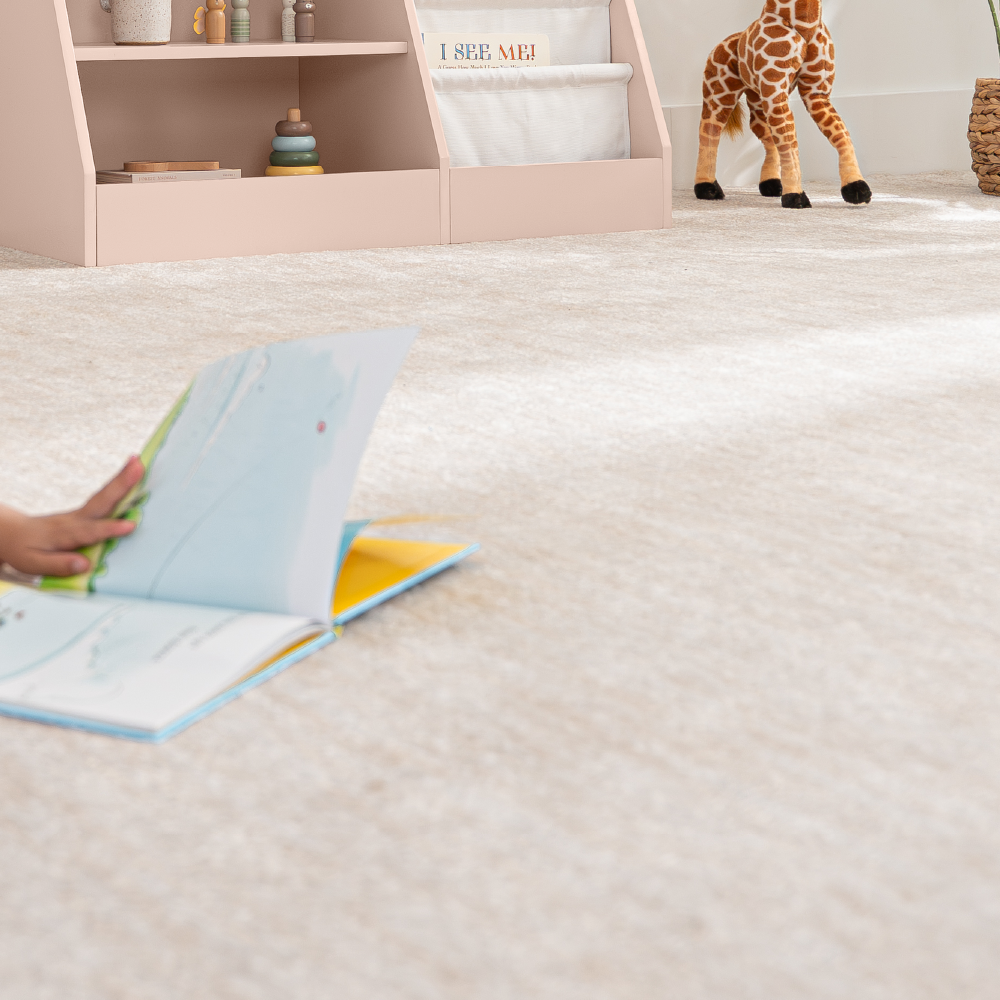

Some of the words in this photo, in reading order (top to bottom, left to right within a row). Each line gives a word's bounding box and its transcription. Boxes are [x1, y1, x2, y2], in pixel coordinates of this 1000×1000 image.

[440, 43, 447, 60] I
[454, 43, 491, 61] SEE
[498, 43, 536, 61] ME!
